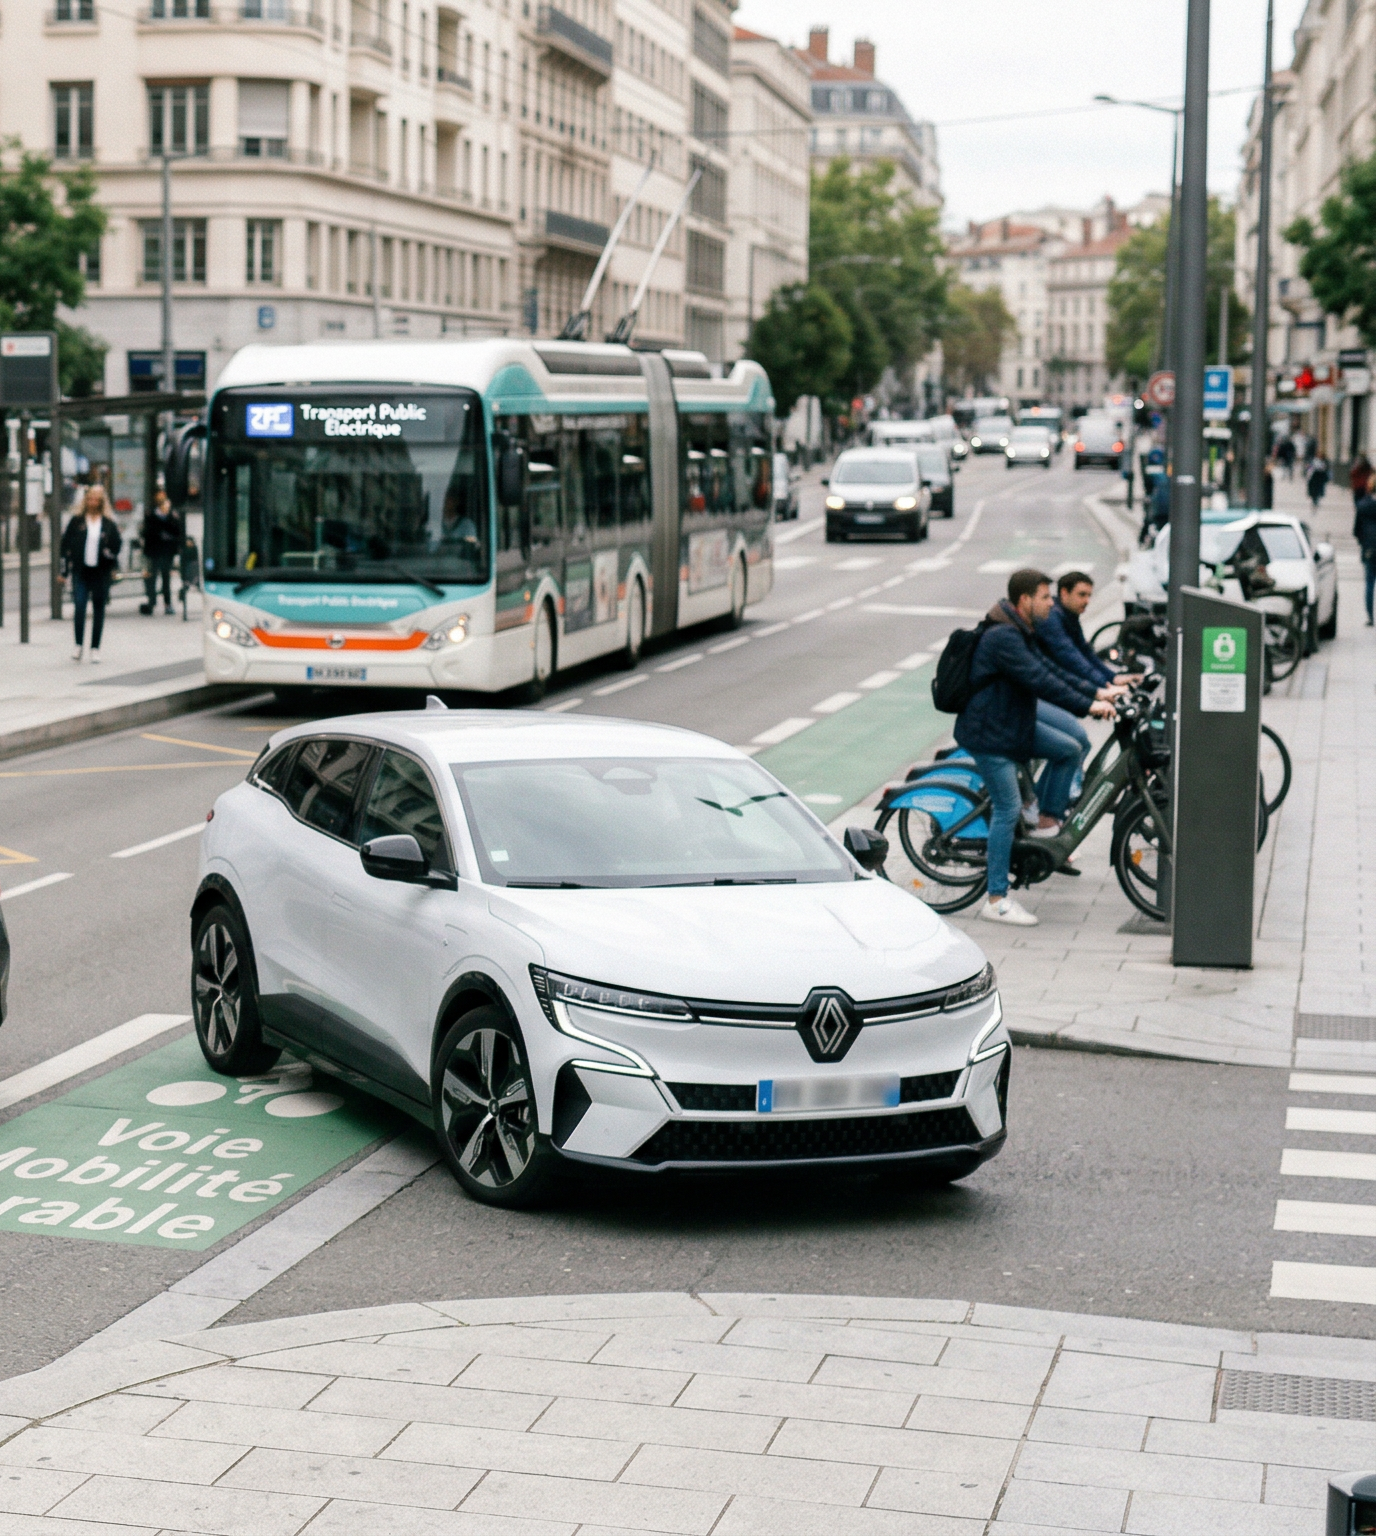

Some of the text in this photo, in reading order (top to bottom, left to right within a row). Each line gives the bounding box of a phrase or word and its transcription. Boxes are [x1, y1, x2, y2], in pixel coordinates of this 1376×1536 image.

[300, 403, 426, 423] Transport Public
[97, 1117, 264, 1160] Voie
